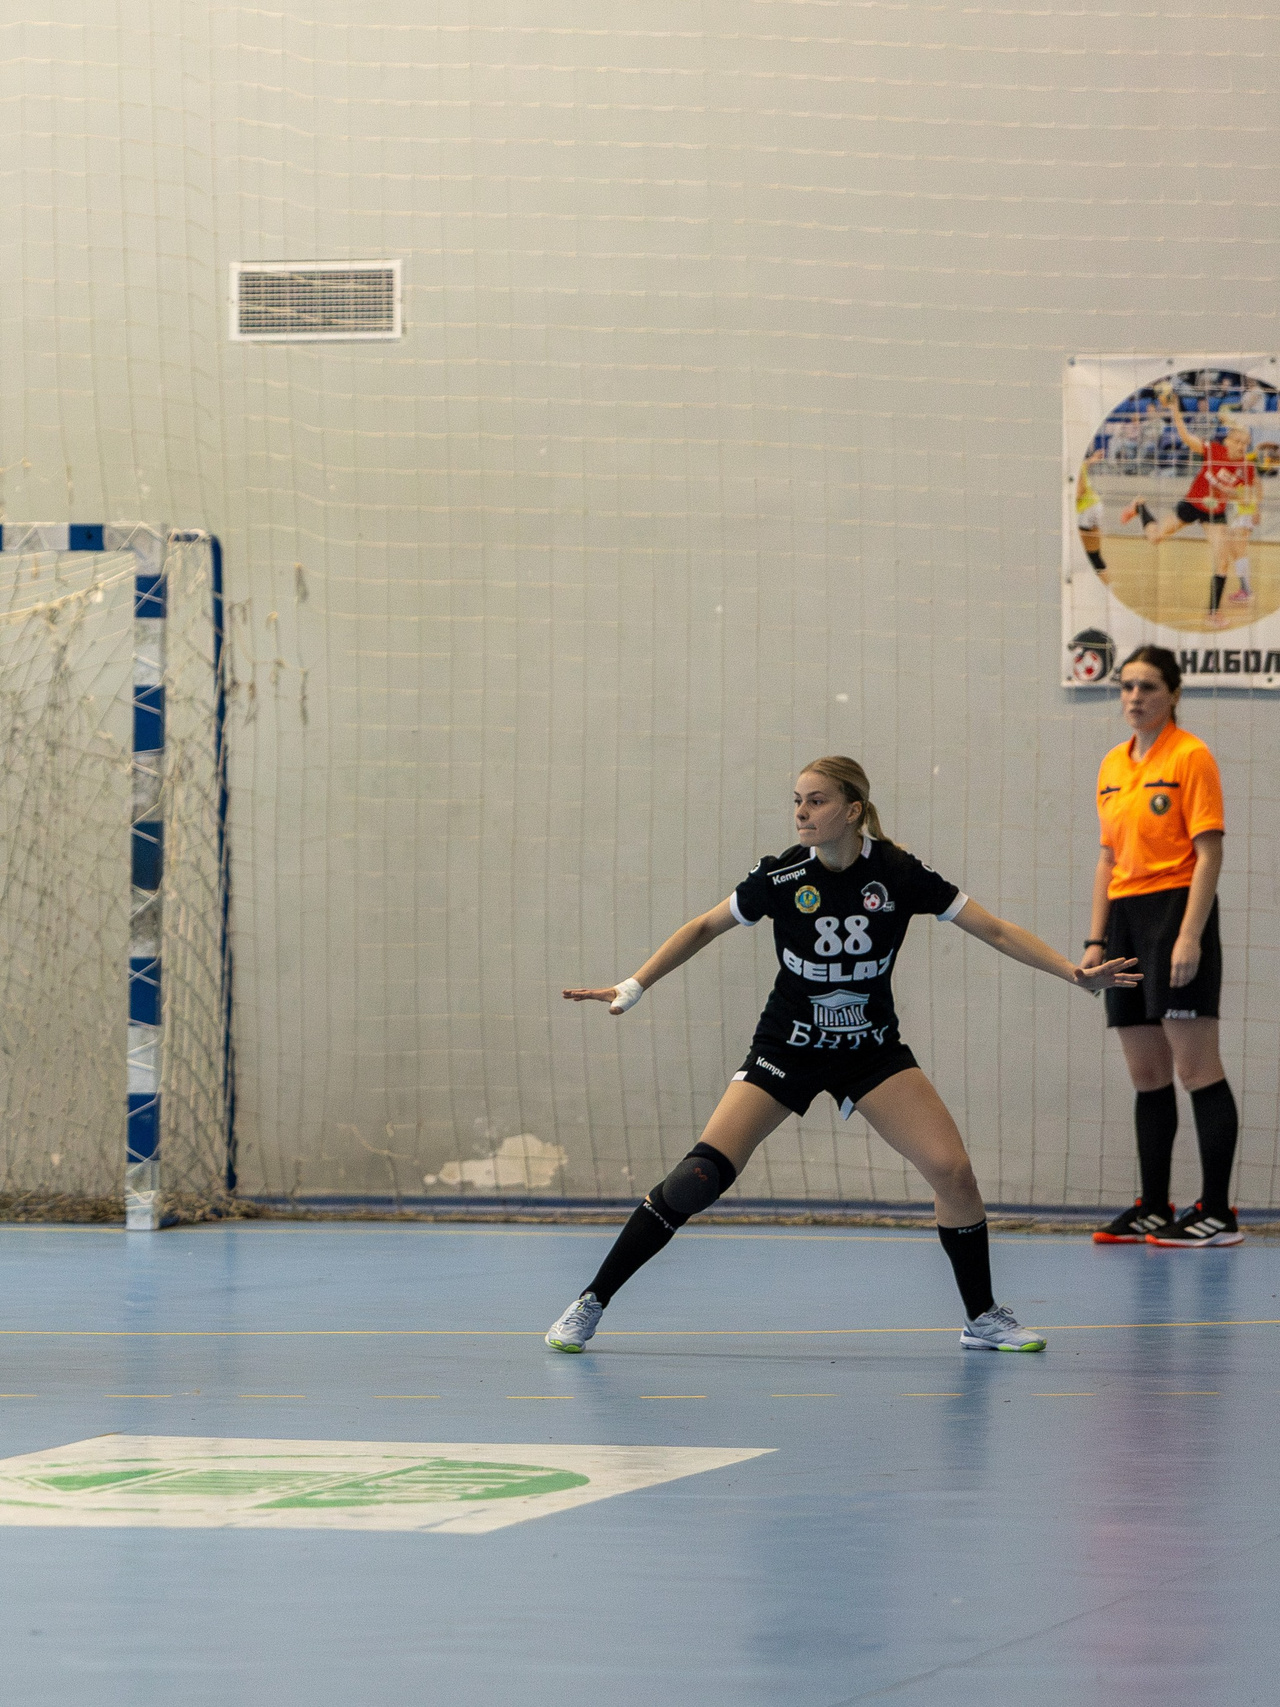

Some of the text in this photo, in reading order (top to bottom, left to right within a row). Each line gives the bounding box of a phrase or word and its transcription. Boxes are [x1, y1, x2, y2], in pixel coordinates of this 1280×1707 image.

[1181, 649, 1280, 674] НДБОЛ
[772, 867, 806, 885] Kempa
[814, 914, 872, 957] 88
[756, 1055, 787, 1079] Kempa
